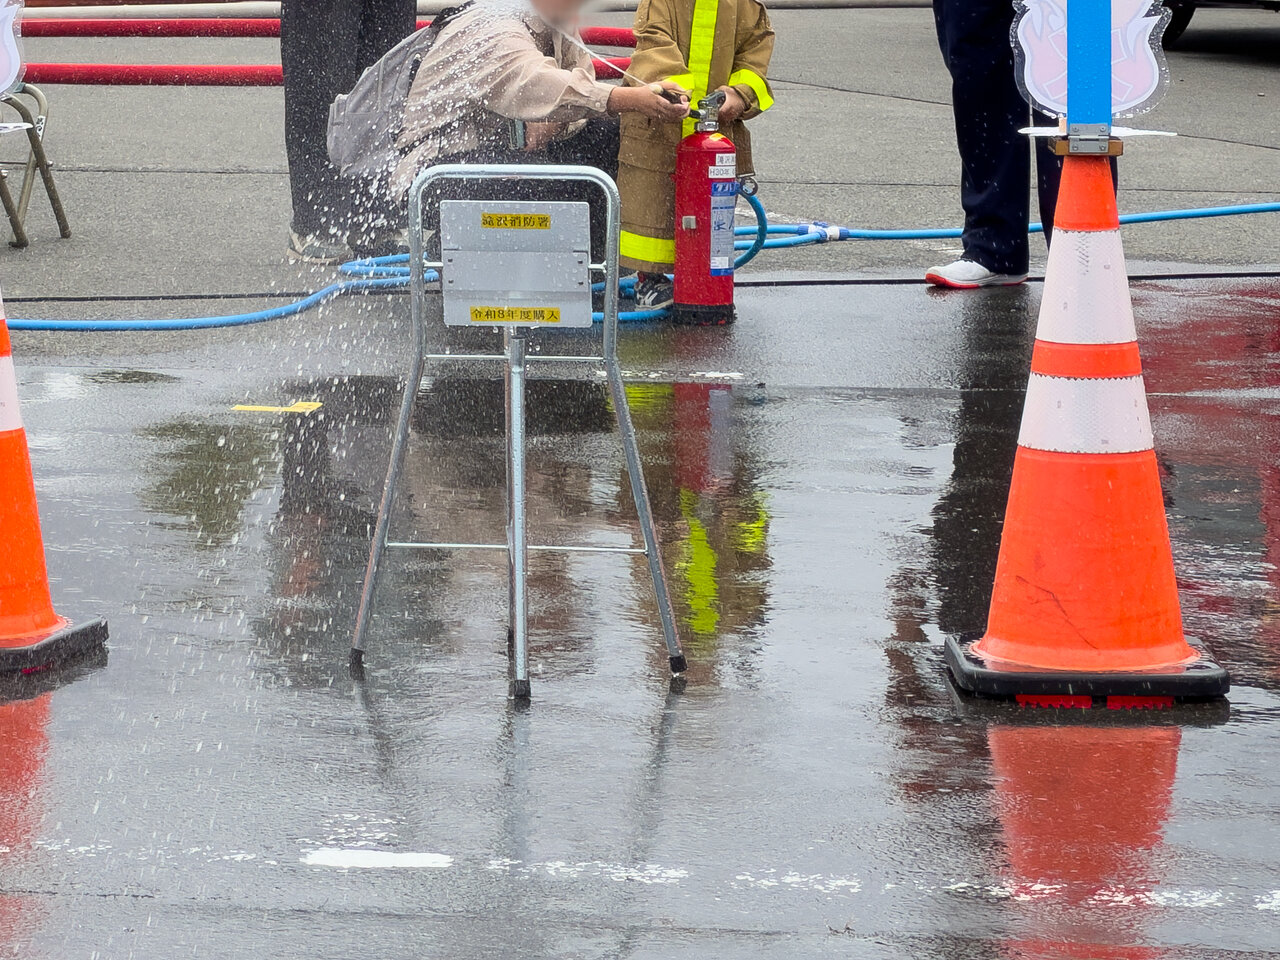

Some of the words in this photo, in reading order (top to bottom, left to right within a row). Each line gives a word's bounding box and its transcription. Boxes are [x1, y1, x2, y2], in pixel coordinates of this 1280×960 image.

[472, 308, 559, 320] 令和8年度購入
